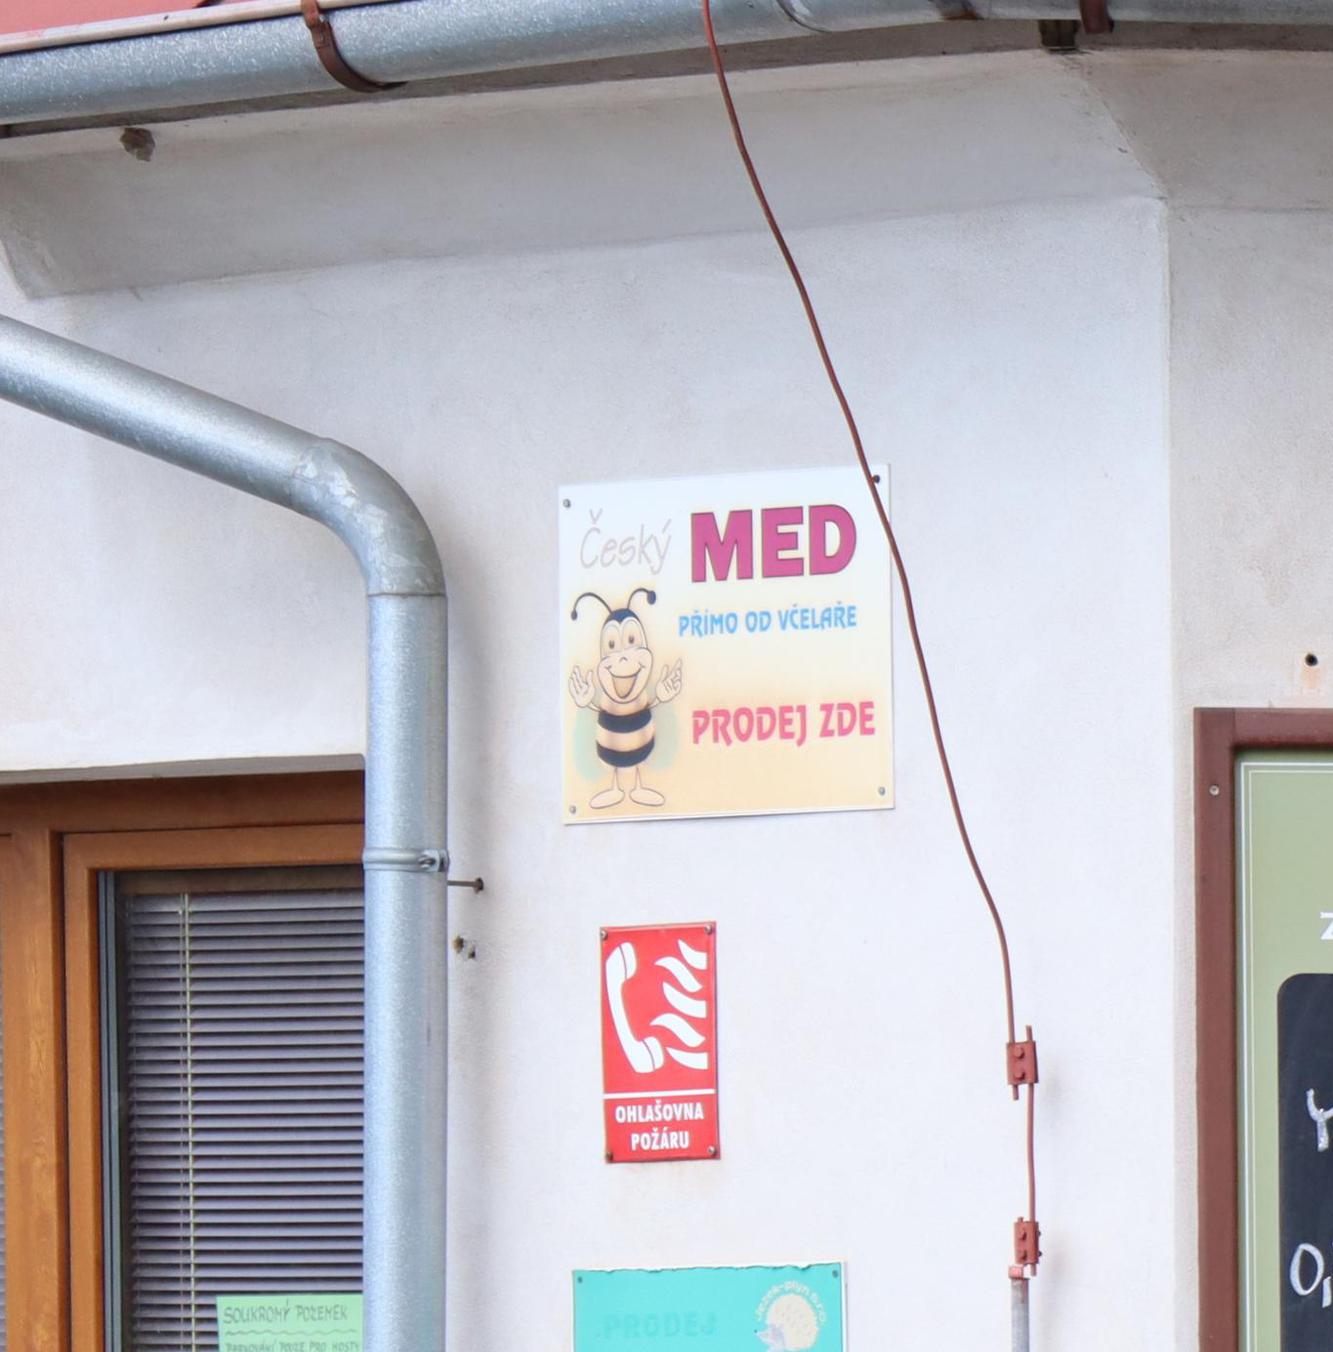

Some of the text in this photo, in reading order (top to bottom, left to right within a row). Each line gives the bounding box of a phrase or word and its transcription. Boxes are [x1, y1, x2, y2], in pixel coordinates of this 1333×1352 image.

[581, 504, 857, 583] Český MED
[679, 601, 856, 637] PŘÍMO OD VČELAŘE
[692, 701, 875, 747] PRODEJ ZDE
[615, 1099, 704, 1123] OHLAŠOVNA
[631, 1126, 689, 1151] POŽÁRU
[223, 1299, 347, 1324] SOUKROMÝ POZEMEK
